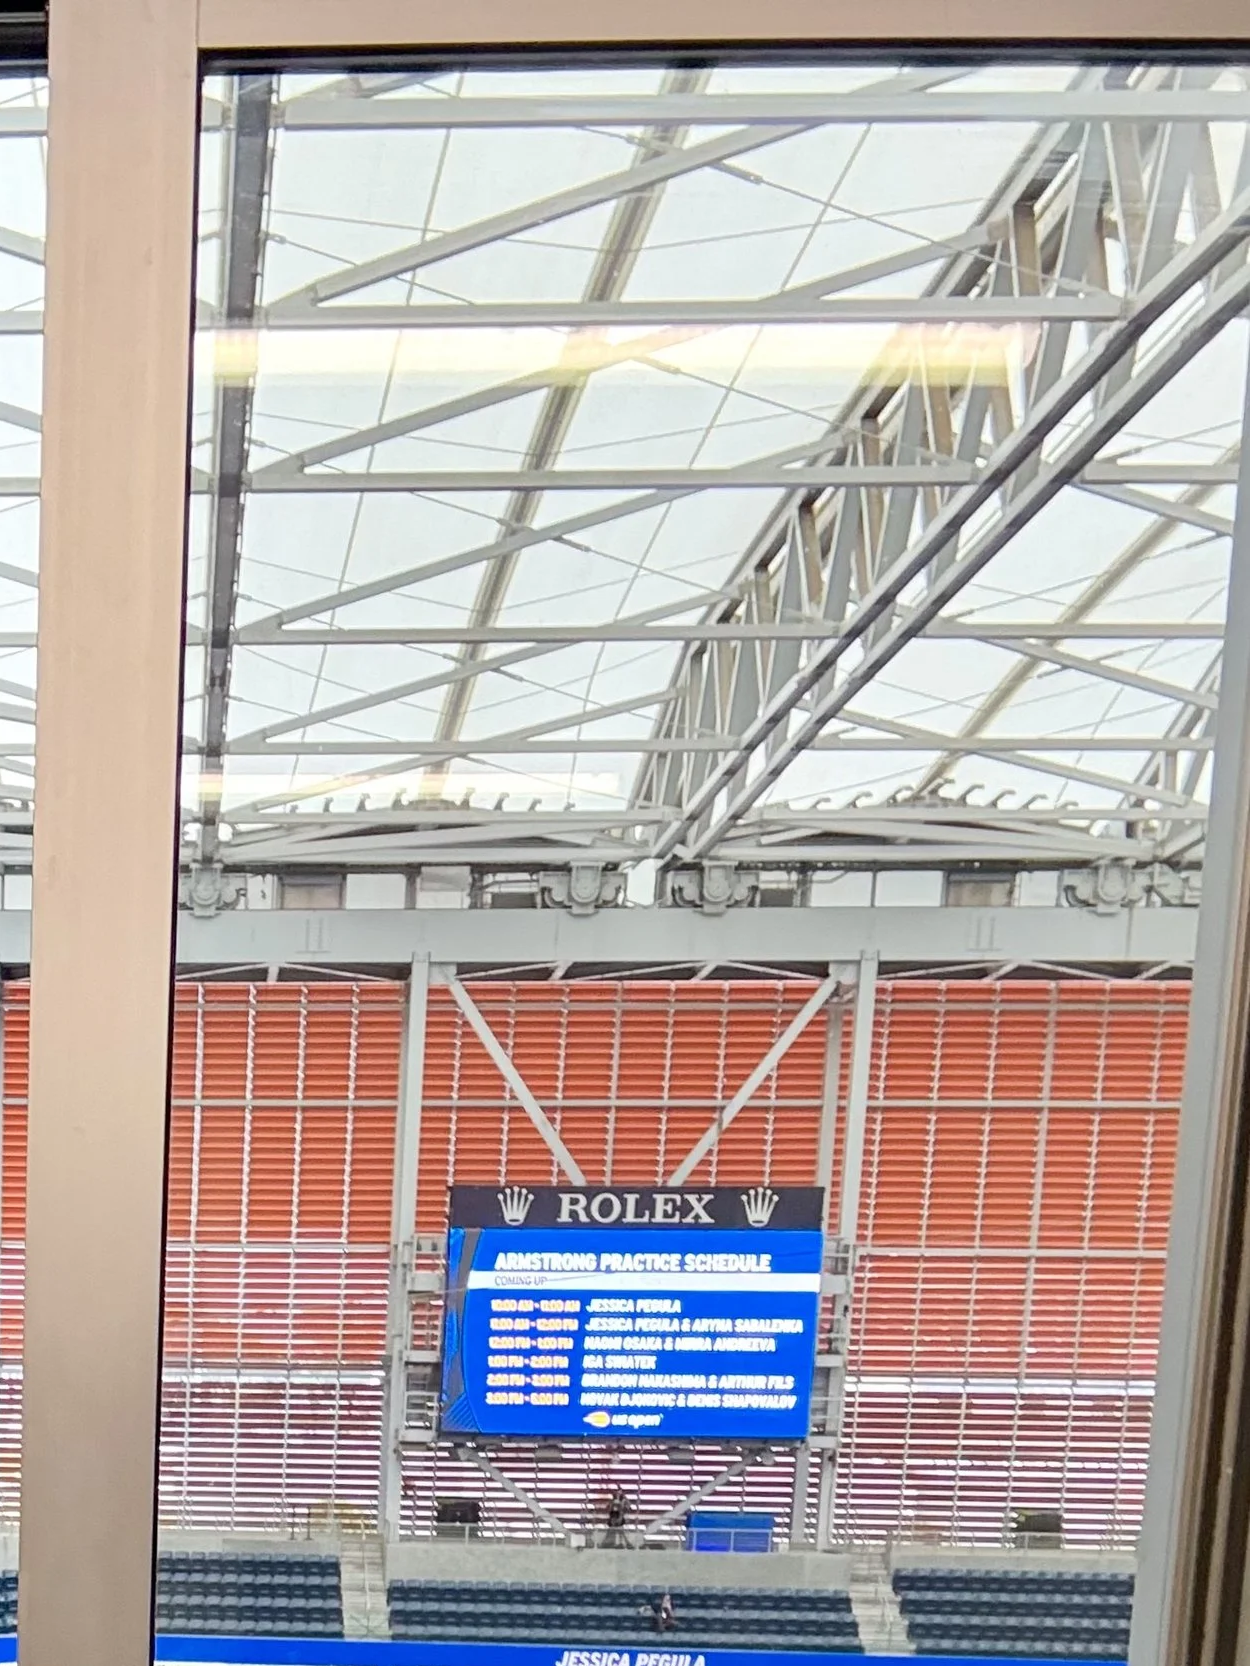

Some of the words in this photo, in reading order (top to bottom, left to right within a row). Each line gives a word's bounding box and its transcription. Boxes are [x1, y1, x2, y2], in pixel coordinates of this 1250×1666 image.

[556, 1192, 715, 1224] ROLEX
[494, 1252, 597, 1272] ARMSTRONG
[600, 1253, 681, 1272] PRACTICE
[684, 1254, 772, 1272] SCHEDULE
[495, 1275, 532, 1286] COMING
[534, 1276, 548, 1286] UP
[586, 1299, 635, 1313] JESSICA
[636, 1299, 681, 1313] PEGULA
[585, 1317, 633, 1331] JESSICA
[634, 1318, 679, 1332] PEGULA
[680, 1318, 691, 1332] &
[623, 1337, 662, 1350] OSAKA
[663, 1337, 674, 1350] &
[583, 1355, 603, 1368] IGA
[707, 1375, 718, 1389] &
[768, 1375, 795, 1390] FILS
[676, 1394, 686, 1407] &
